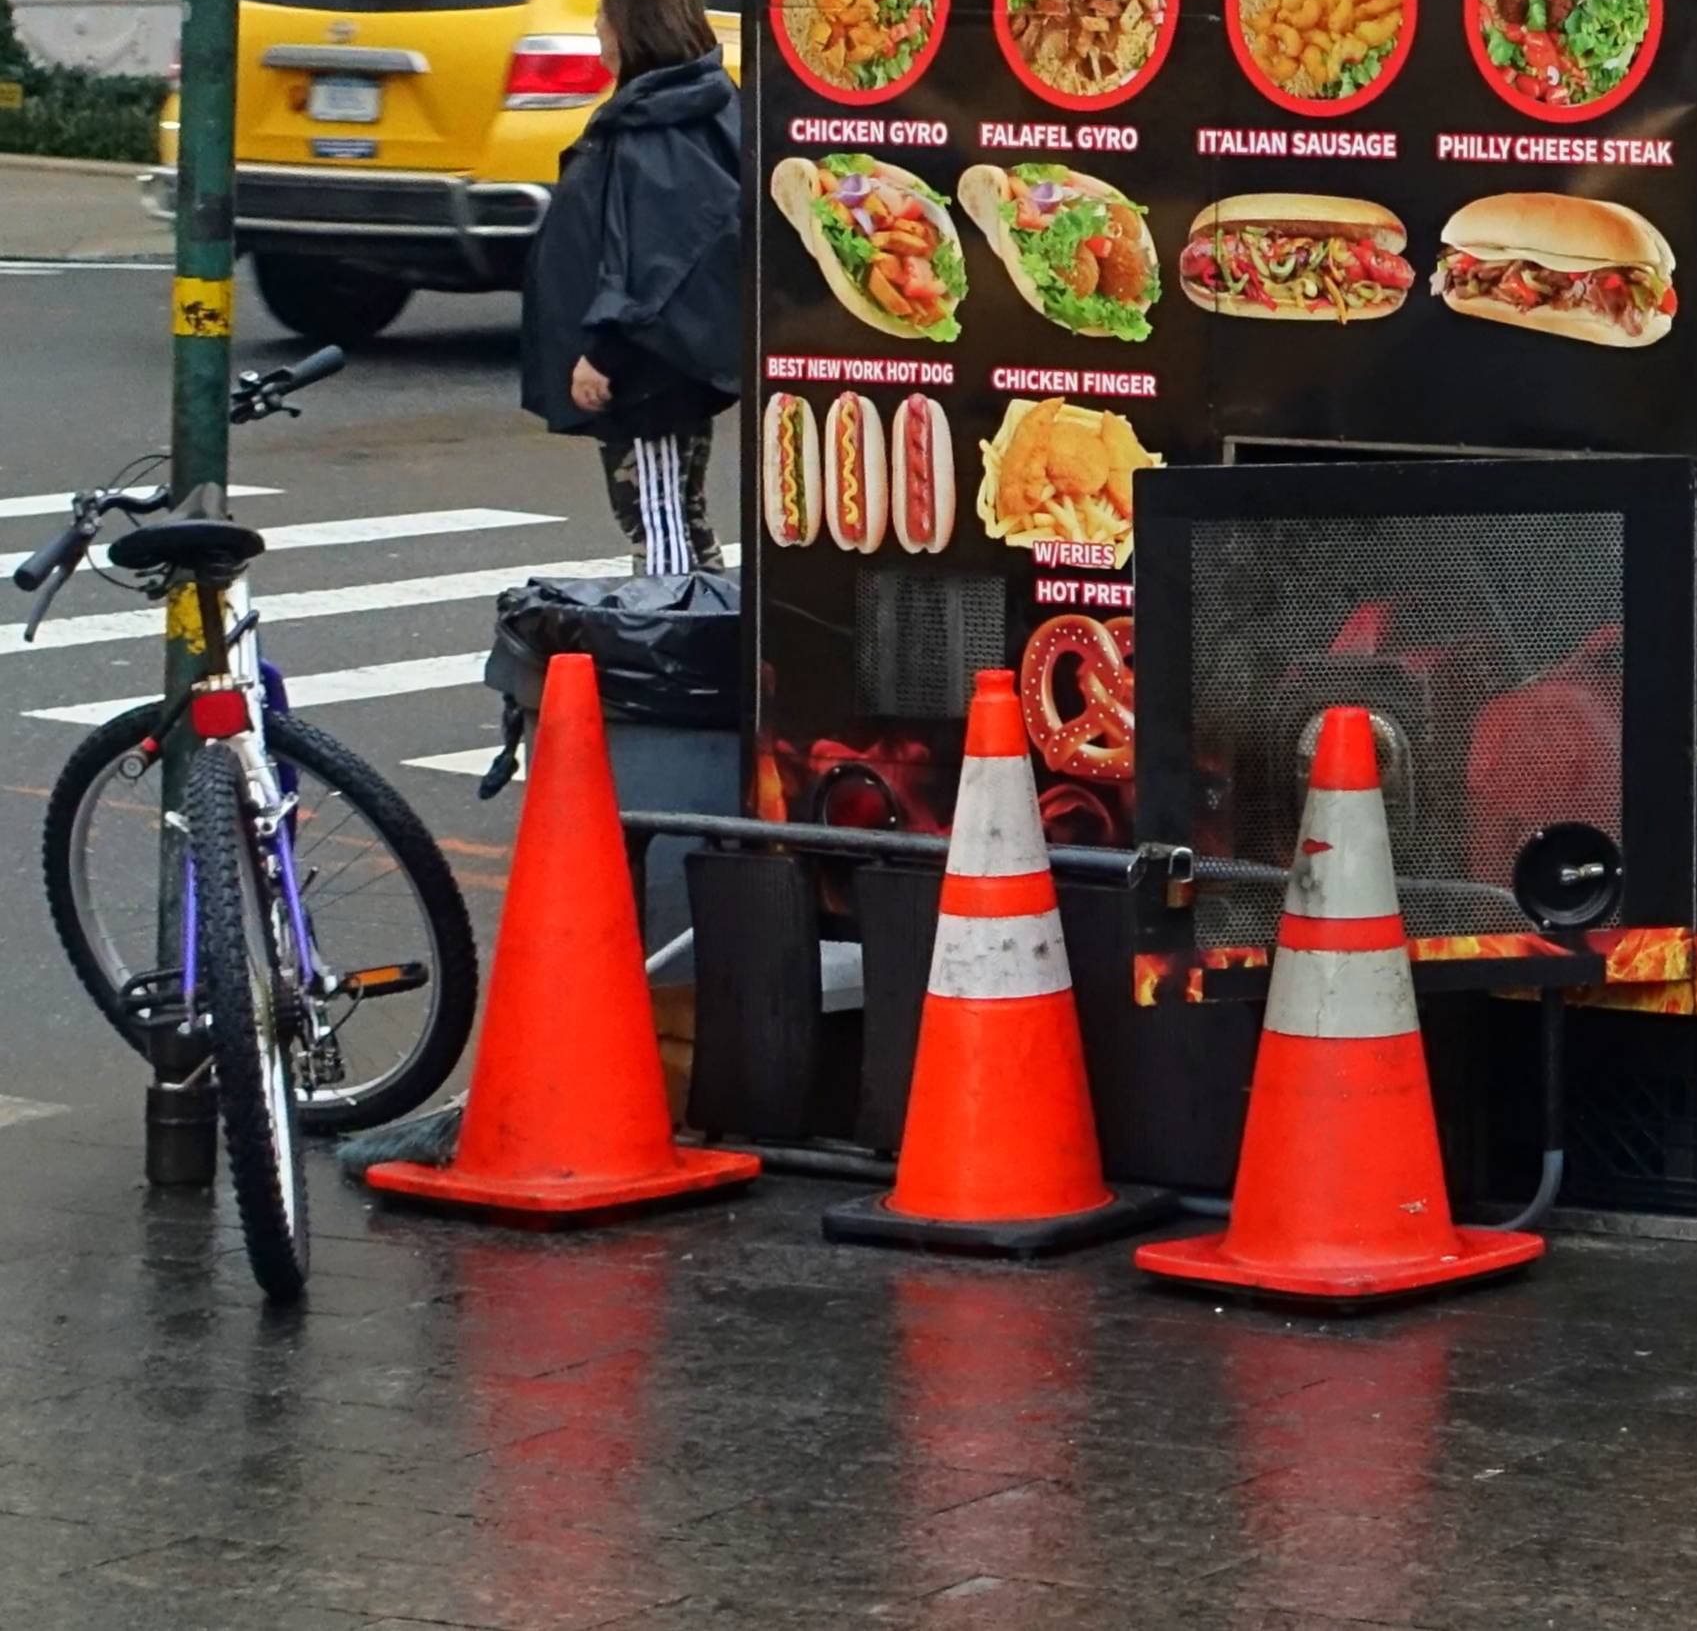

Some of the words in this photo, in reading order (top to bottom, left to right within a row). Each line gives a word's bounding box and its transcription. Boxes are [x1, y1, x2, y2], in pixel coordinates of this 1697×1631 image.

[790, 118, 885, 143] CHICKEN
[890, 120, 949, 147] GYRO
[980, 122, 1072, 149] FALAFEL
[1077, 125, 1138, 152] GYRO
[1197, 129, 1288, 156] ITALIAN
[1292, 132, 1398, 159] SAUSAGE
[1438, 134, 1512, 161] PHILLY
[1515, 136, 1598, 163] CHEESE
[1602, 138, 1674, 166] STEAK
[768, 356, 805, 380] BEST
[807, 358, 841, 381] NEW
[841, 359, 884, 382] YORK
[885, 361, 919, 384] HOT
[920, 362, 954, 385] DOG
[992, 369, 1079, 393] CHICKEN
[1082, 371, 1157, 396] FINGER
[1033, 540, 1116, 567] W/FRIES
[1036, 579, 1079, 603] HOT
[1081, 581, 1135, 607] PRET
